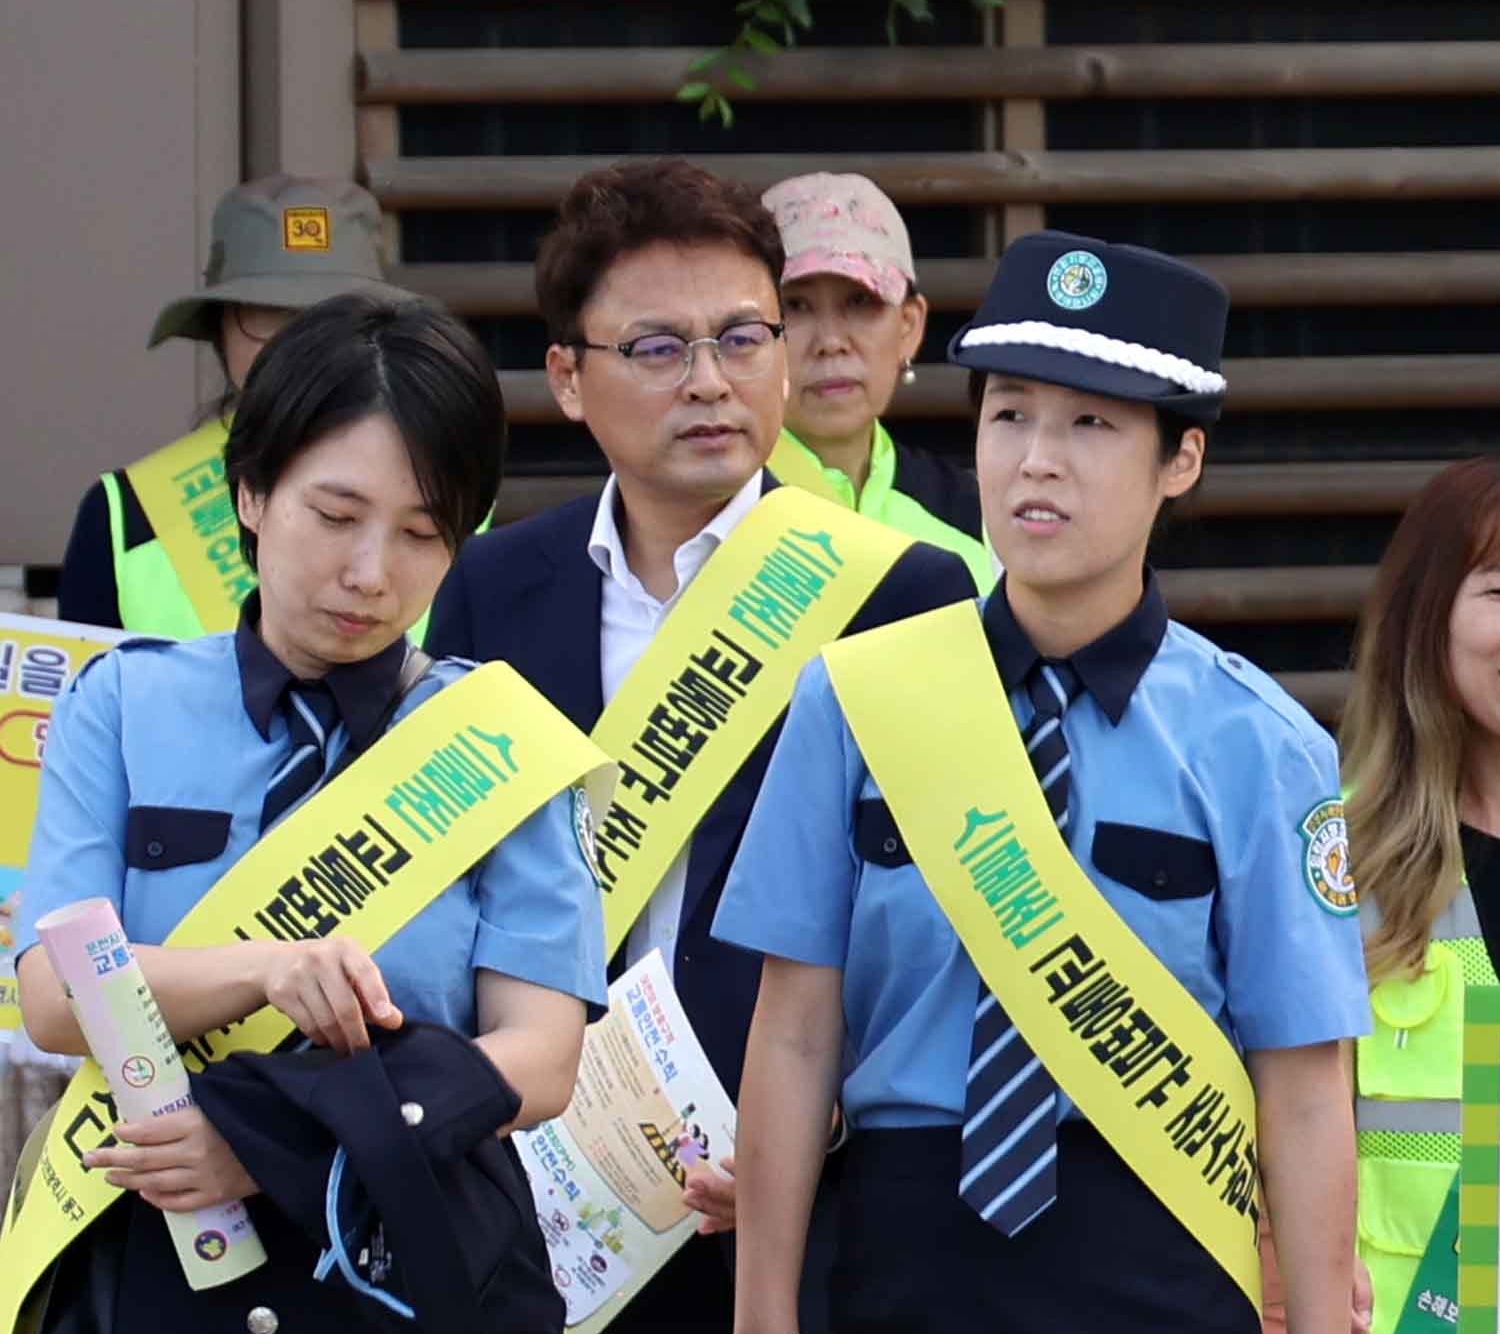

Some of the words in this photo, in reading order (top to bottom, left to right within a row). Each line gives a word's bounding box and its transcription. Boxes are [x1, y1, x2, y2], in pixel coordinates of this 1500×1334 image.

[729, 527, 845, 650] 스쿨존
[618, 629, 765, 805] 교통법규
[384, 725, 520, 844] 스쿨존
[233, 813, 414, 942] 교통법
[953, 806, 1065, 951] 스쿨존
[1029, 933, 1191, 1110] 교통법규
